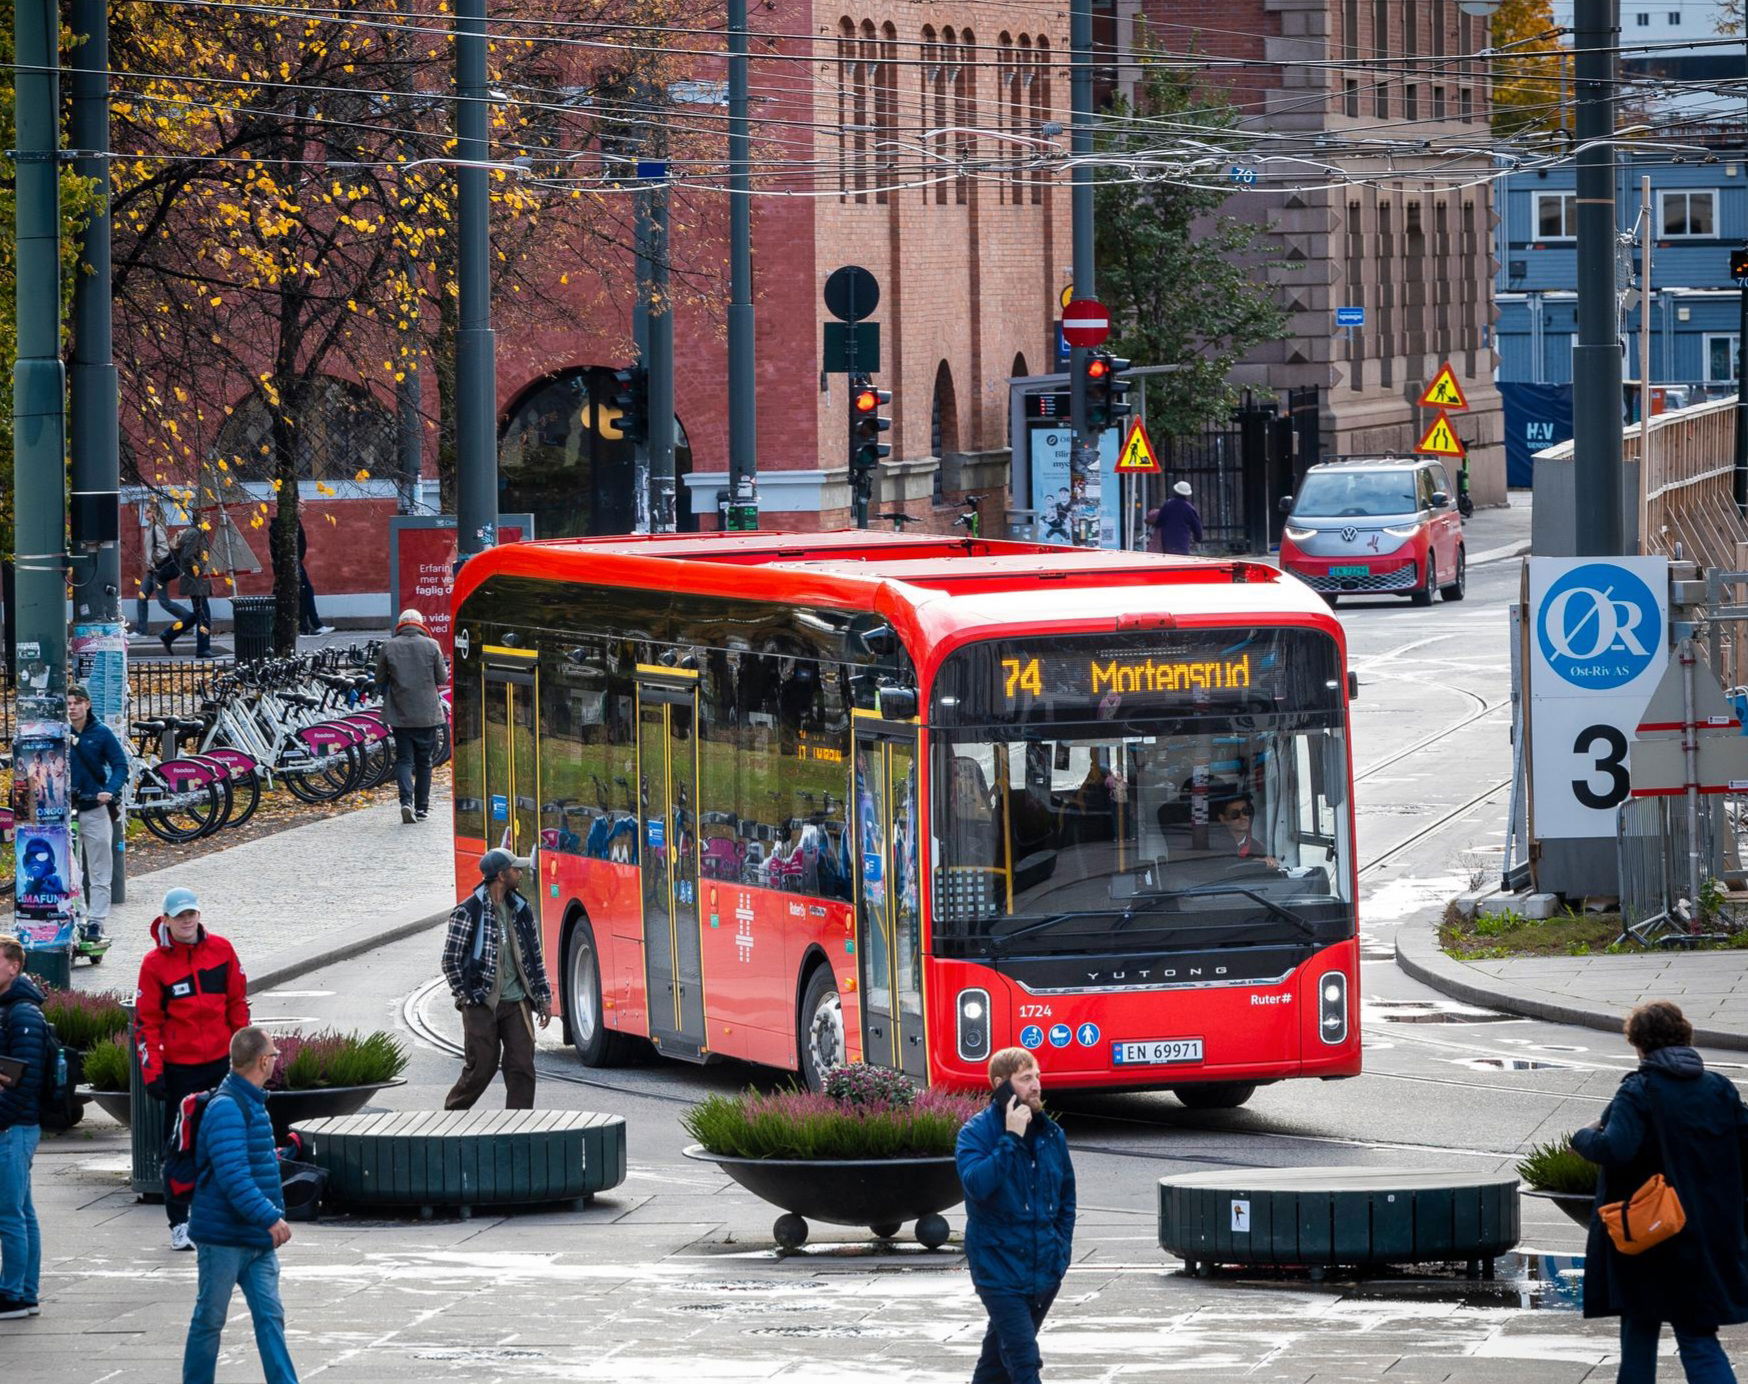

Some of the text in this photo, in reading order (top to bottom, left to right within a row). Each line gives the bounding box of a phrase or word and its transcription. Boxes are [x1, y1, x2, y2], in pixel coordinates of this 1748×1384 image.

[1235, 167, 1253, 183] 70
[1526, 422, 1554, 440] HAV
[416, 585, 443, 596] faglig
[430, 624, 447, 633] ved
[1001, 654, 1250, 697] 74 Mortensrud
[1570, 665, 1630, 678] Øst-Riv AS
[1571, 724, 1632, 810] 3
[1087, 966, 1228, 980] YUTONG
[1250, 992, 1292, 1006] Ruter#
[1019, 1005, 1052, 1018] 1724
[1127, 1043, 1198, 1060] EN 69971
